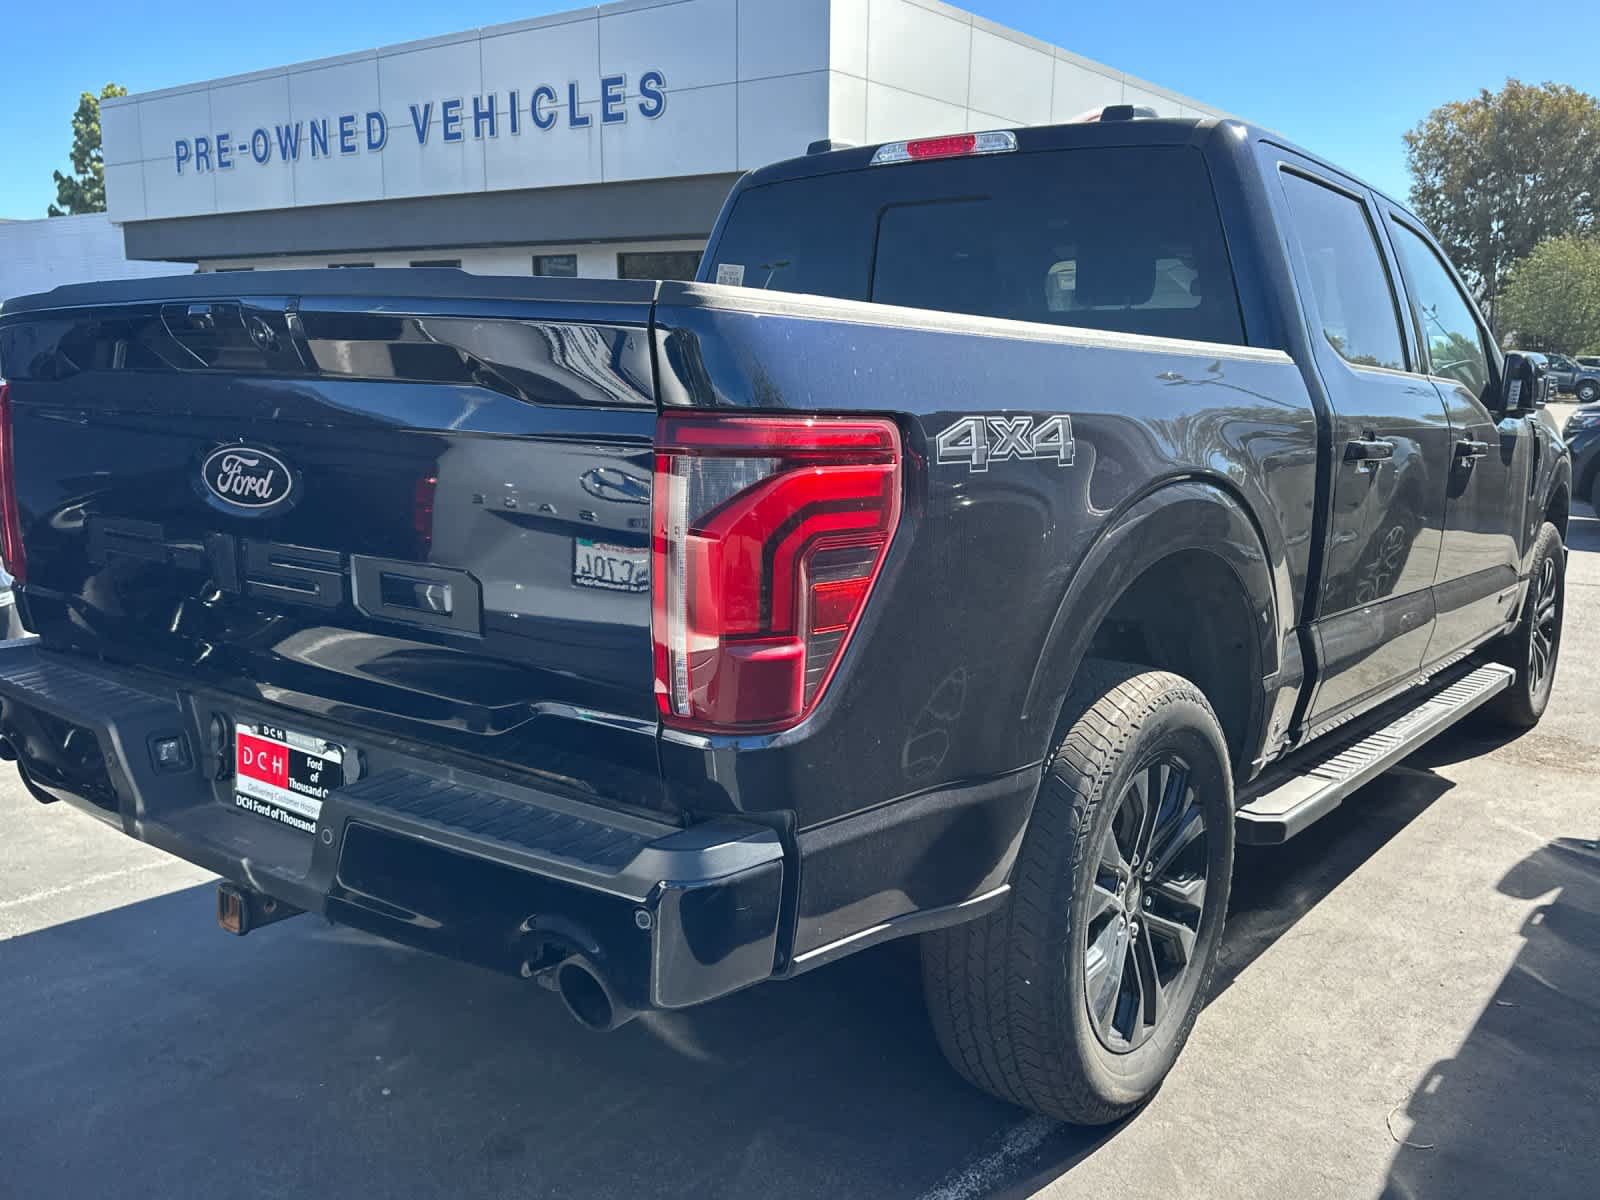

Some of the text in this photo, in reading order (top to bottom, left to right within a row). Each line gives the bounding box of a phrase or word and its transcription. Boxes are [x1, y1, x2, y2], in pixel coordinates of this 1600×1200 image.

[174, 69, 667, 175] PRE-OWNED VEHICLES
[217, 454, 273, 499] Ford
[263, 725, 283, 739] DCH
[243, 746, 283, 775] DCH
[306, 757, 323, 771] Ford
[288, 777, 322, 798] Thousand
[310, 772, 319, 783] of
[236, 795, 316, 834] DCH Ford of Thousand
